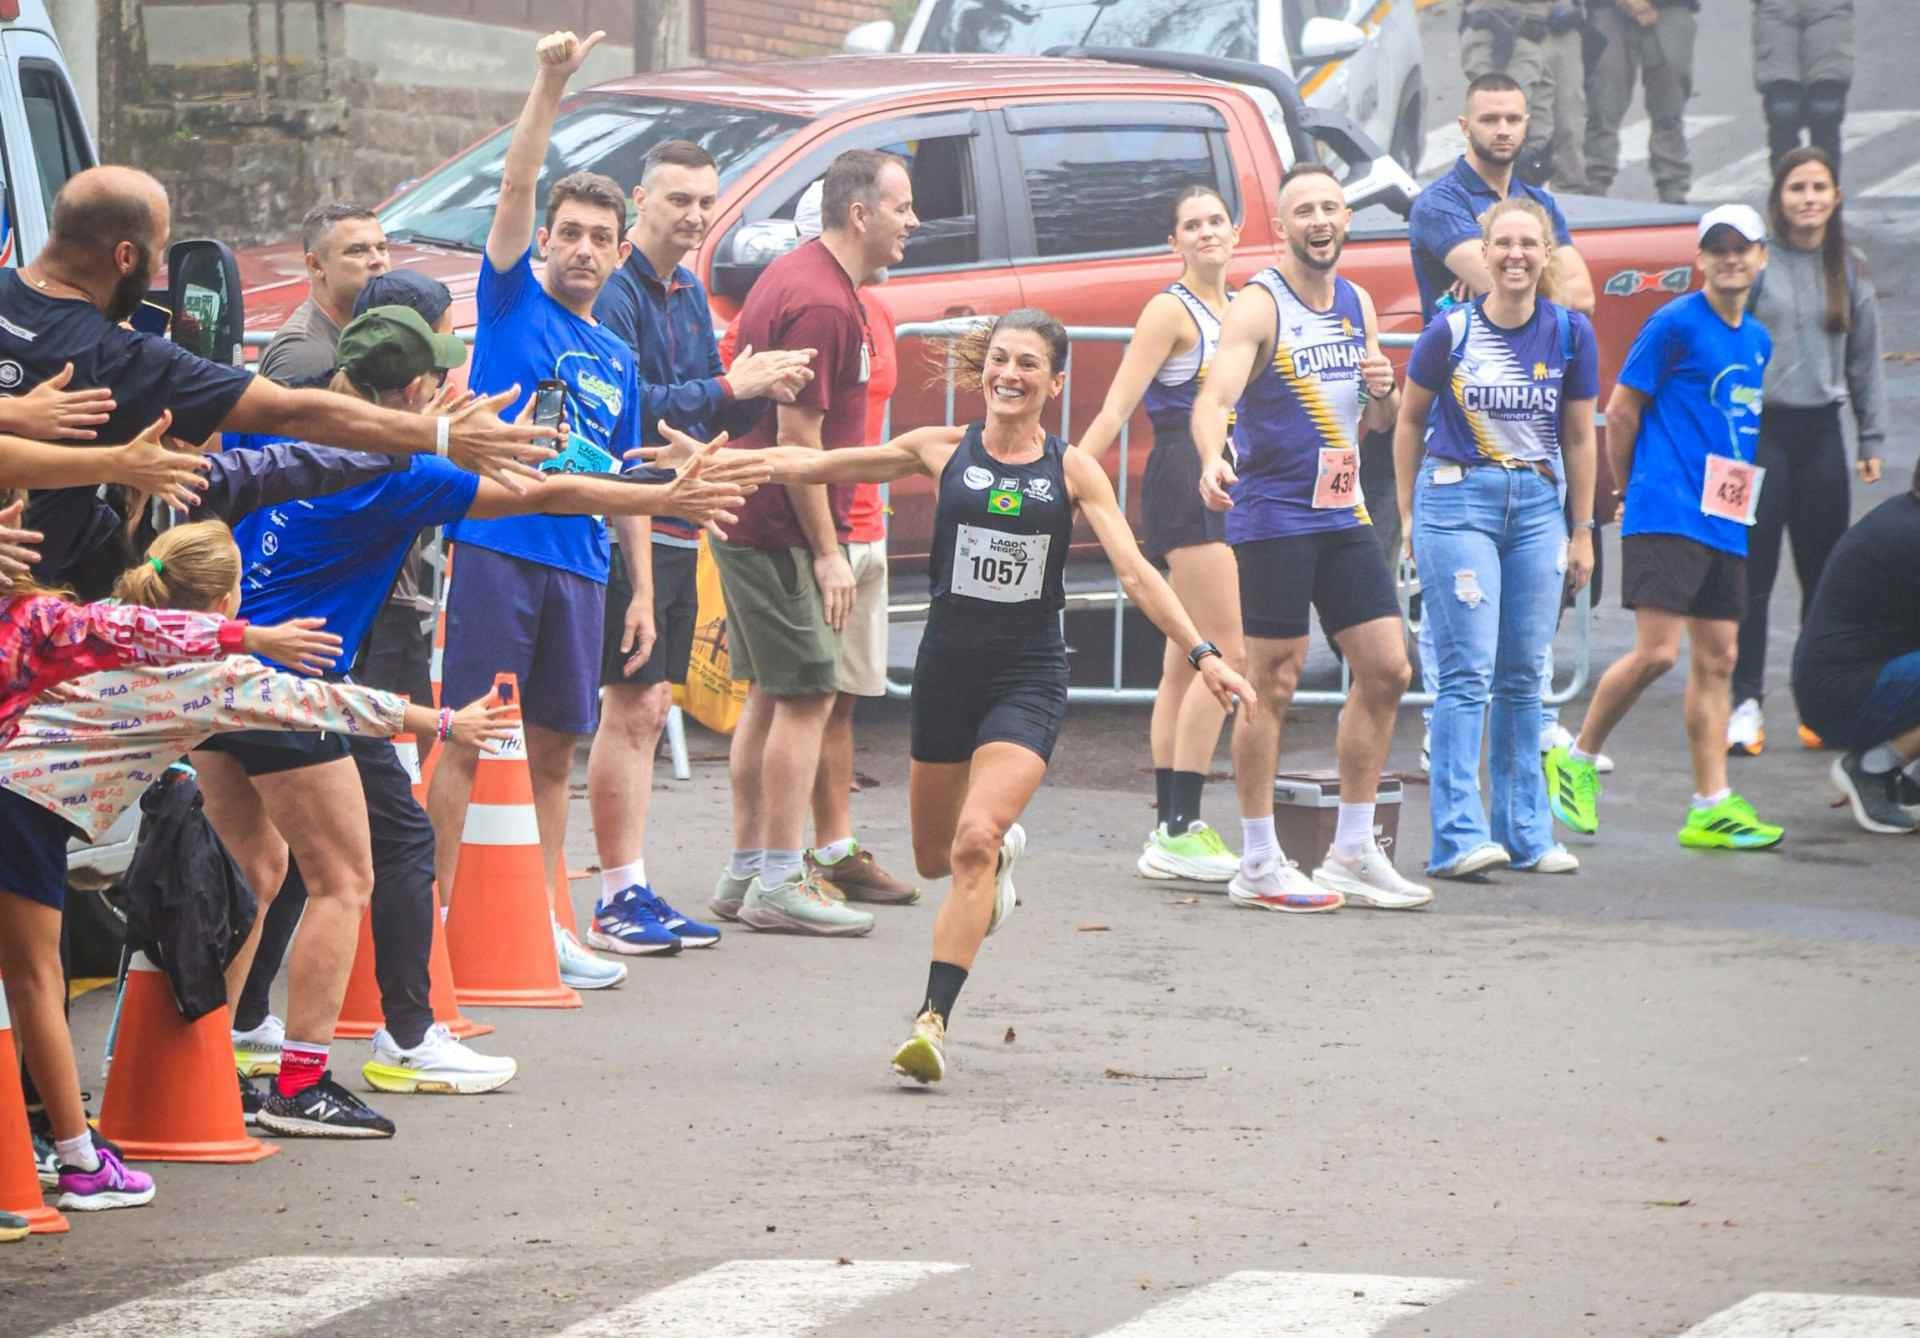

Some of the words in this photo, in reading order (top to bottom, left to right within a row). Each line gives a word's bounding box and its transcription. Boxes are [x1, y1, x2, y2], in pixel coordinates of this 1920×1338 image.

[1464, 386, 1558, 413] CUNHAS
[991, 538, 1018, 548] LAGO
[971, 556, 1028, 585] 1057
[100, 684, 128, 698] FILA
[183, 695, 212, 713] FILA
[224, 687, 235, 711] FILA
[145, 709, 176, 723] FILA
[111, 718, 142, 731] FILA
[50, 760, 80, 774] FILA
[12, 768, 43, 781] FILA
[62, 793, 88, 806] FILA
